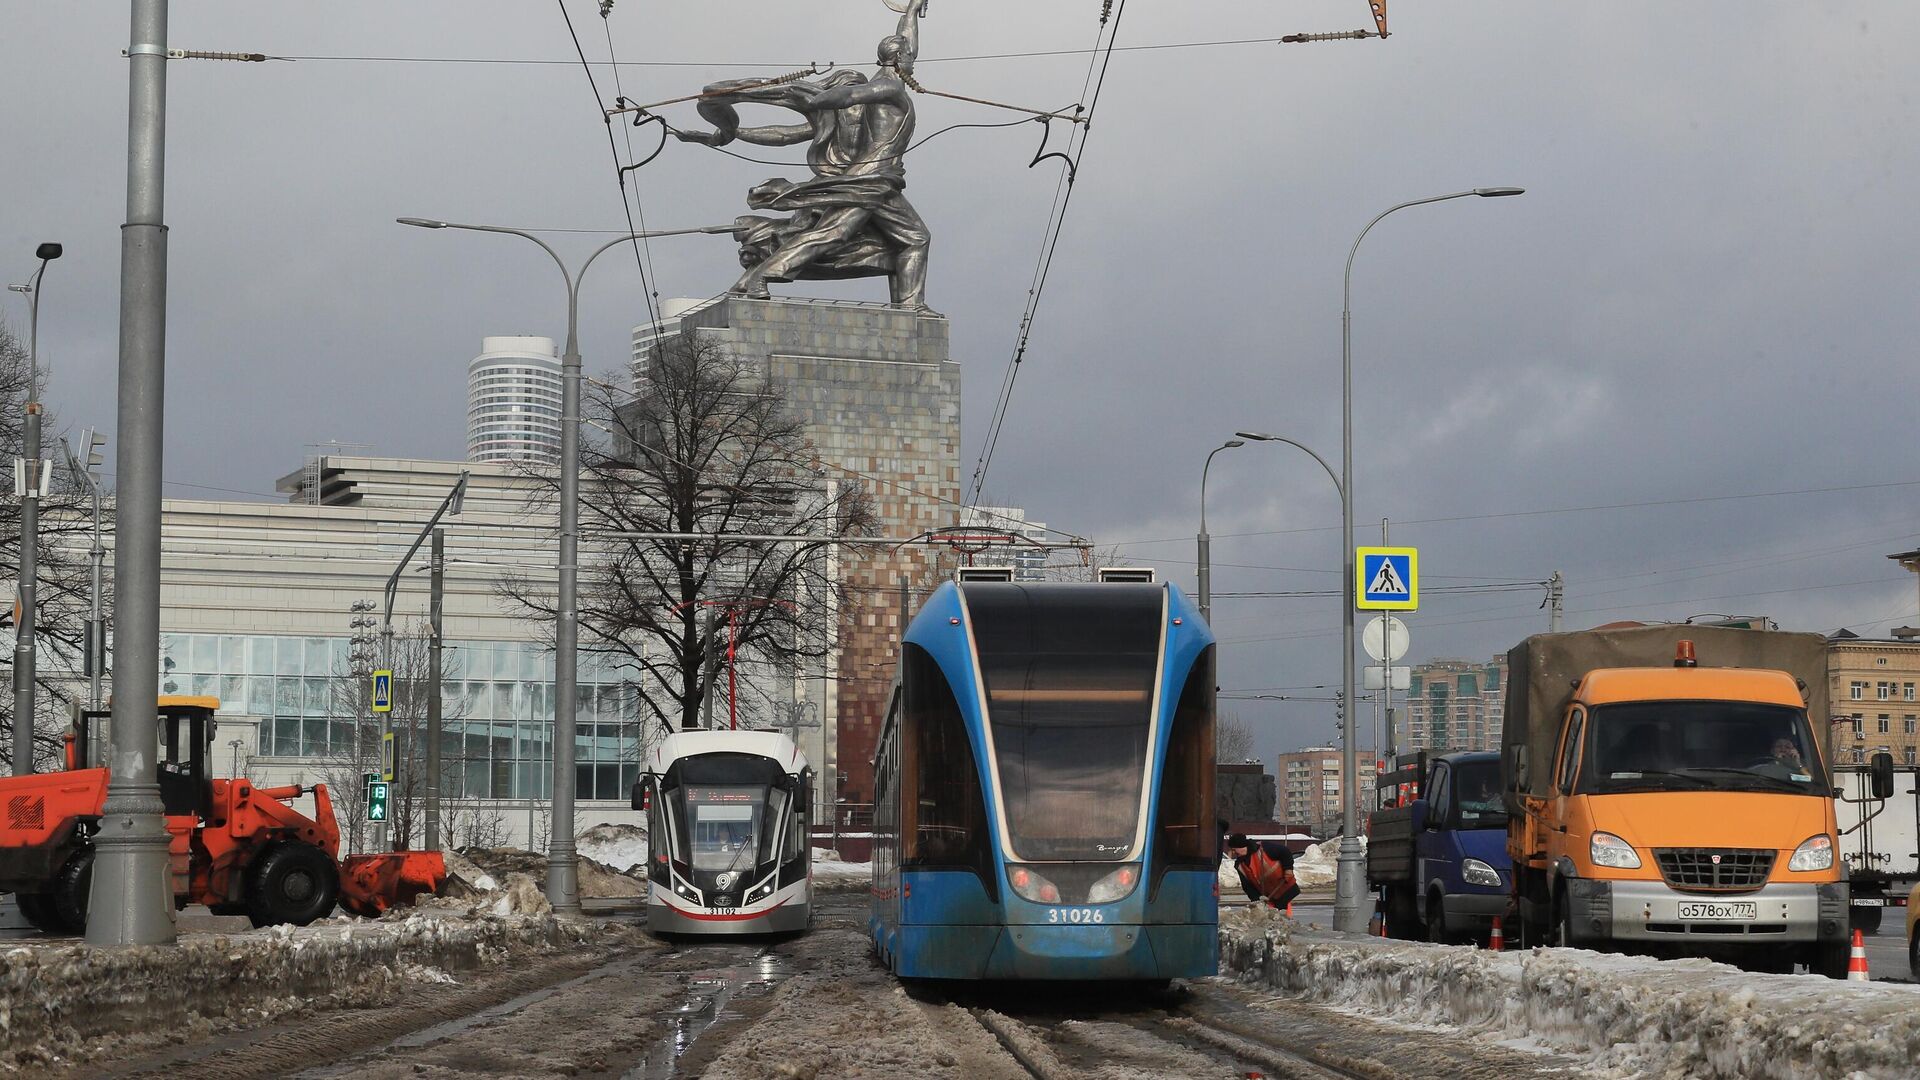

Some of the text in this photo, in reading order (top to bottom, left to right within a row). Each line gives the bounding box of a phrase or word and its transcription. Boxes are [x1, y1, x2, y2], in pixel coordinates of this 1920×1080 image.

[375, 786, 386, 799] 13
[709, 907, 736, 915] 31102
[1048, 908, 1103, 923] 31026
